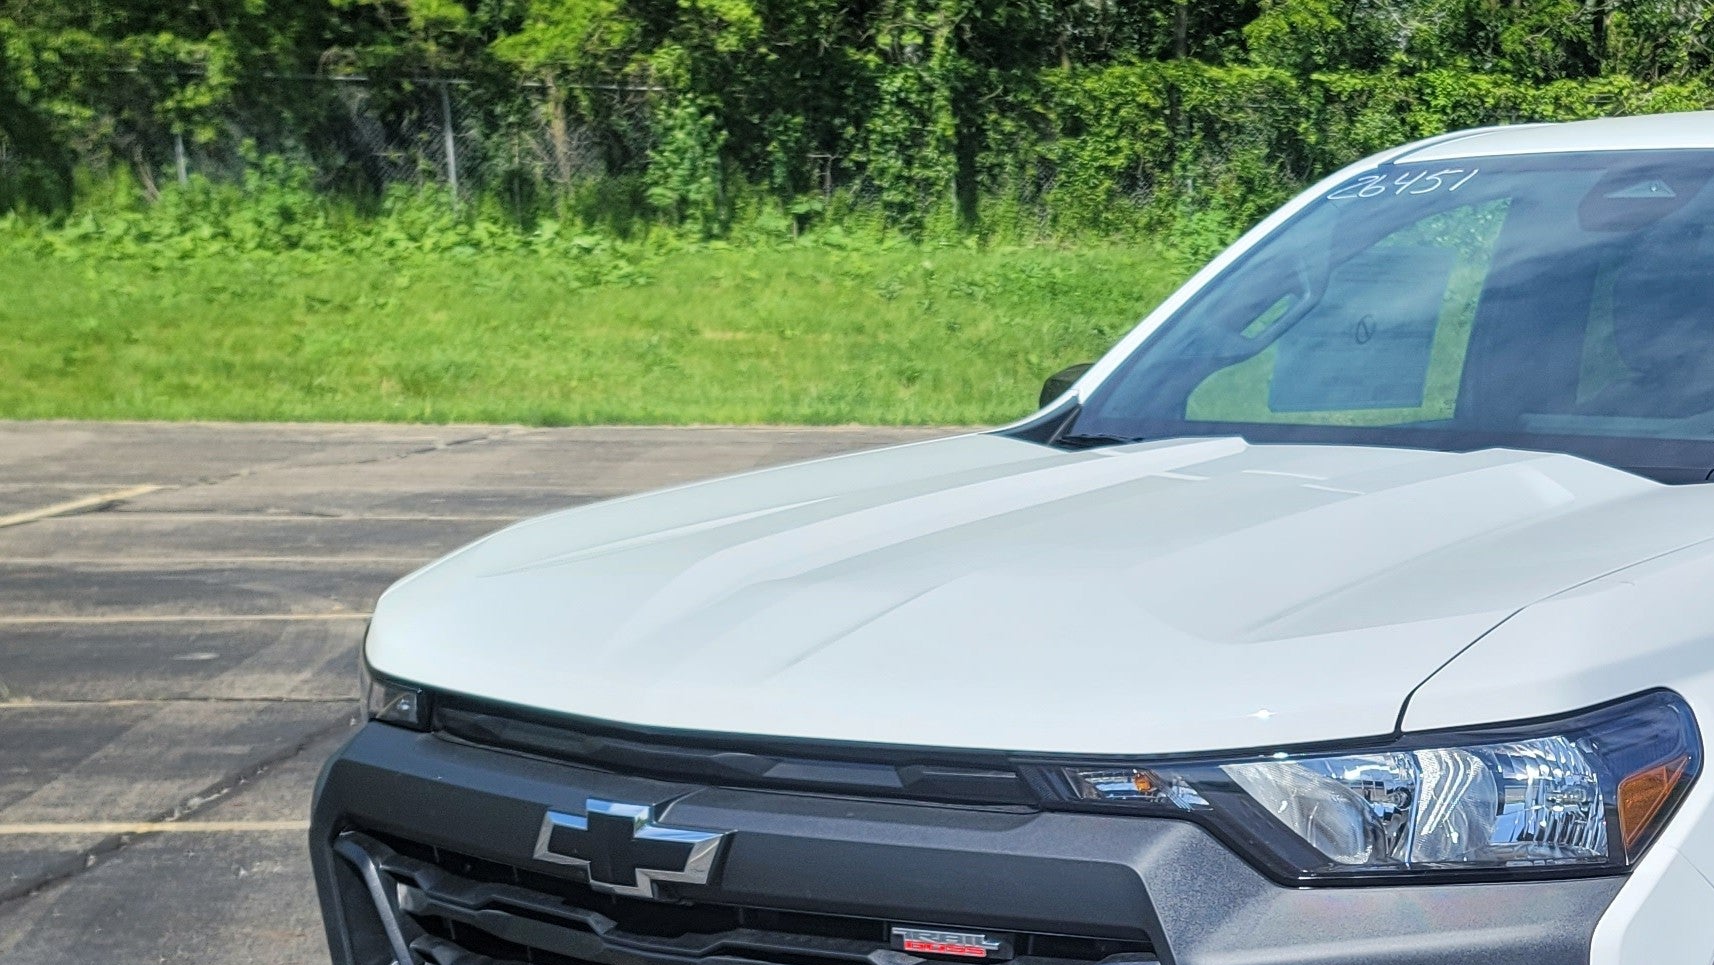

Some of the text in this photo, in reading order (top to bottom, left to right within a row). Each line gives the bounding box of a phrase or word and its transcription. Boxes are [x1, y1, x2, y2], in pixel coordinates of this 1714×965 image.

[1326, 168, 1479, 200] 26451
[891, 926, 1000, 950] TRAIL
[903, 938, 988, 958] BOSS
